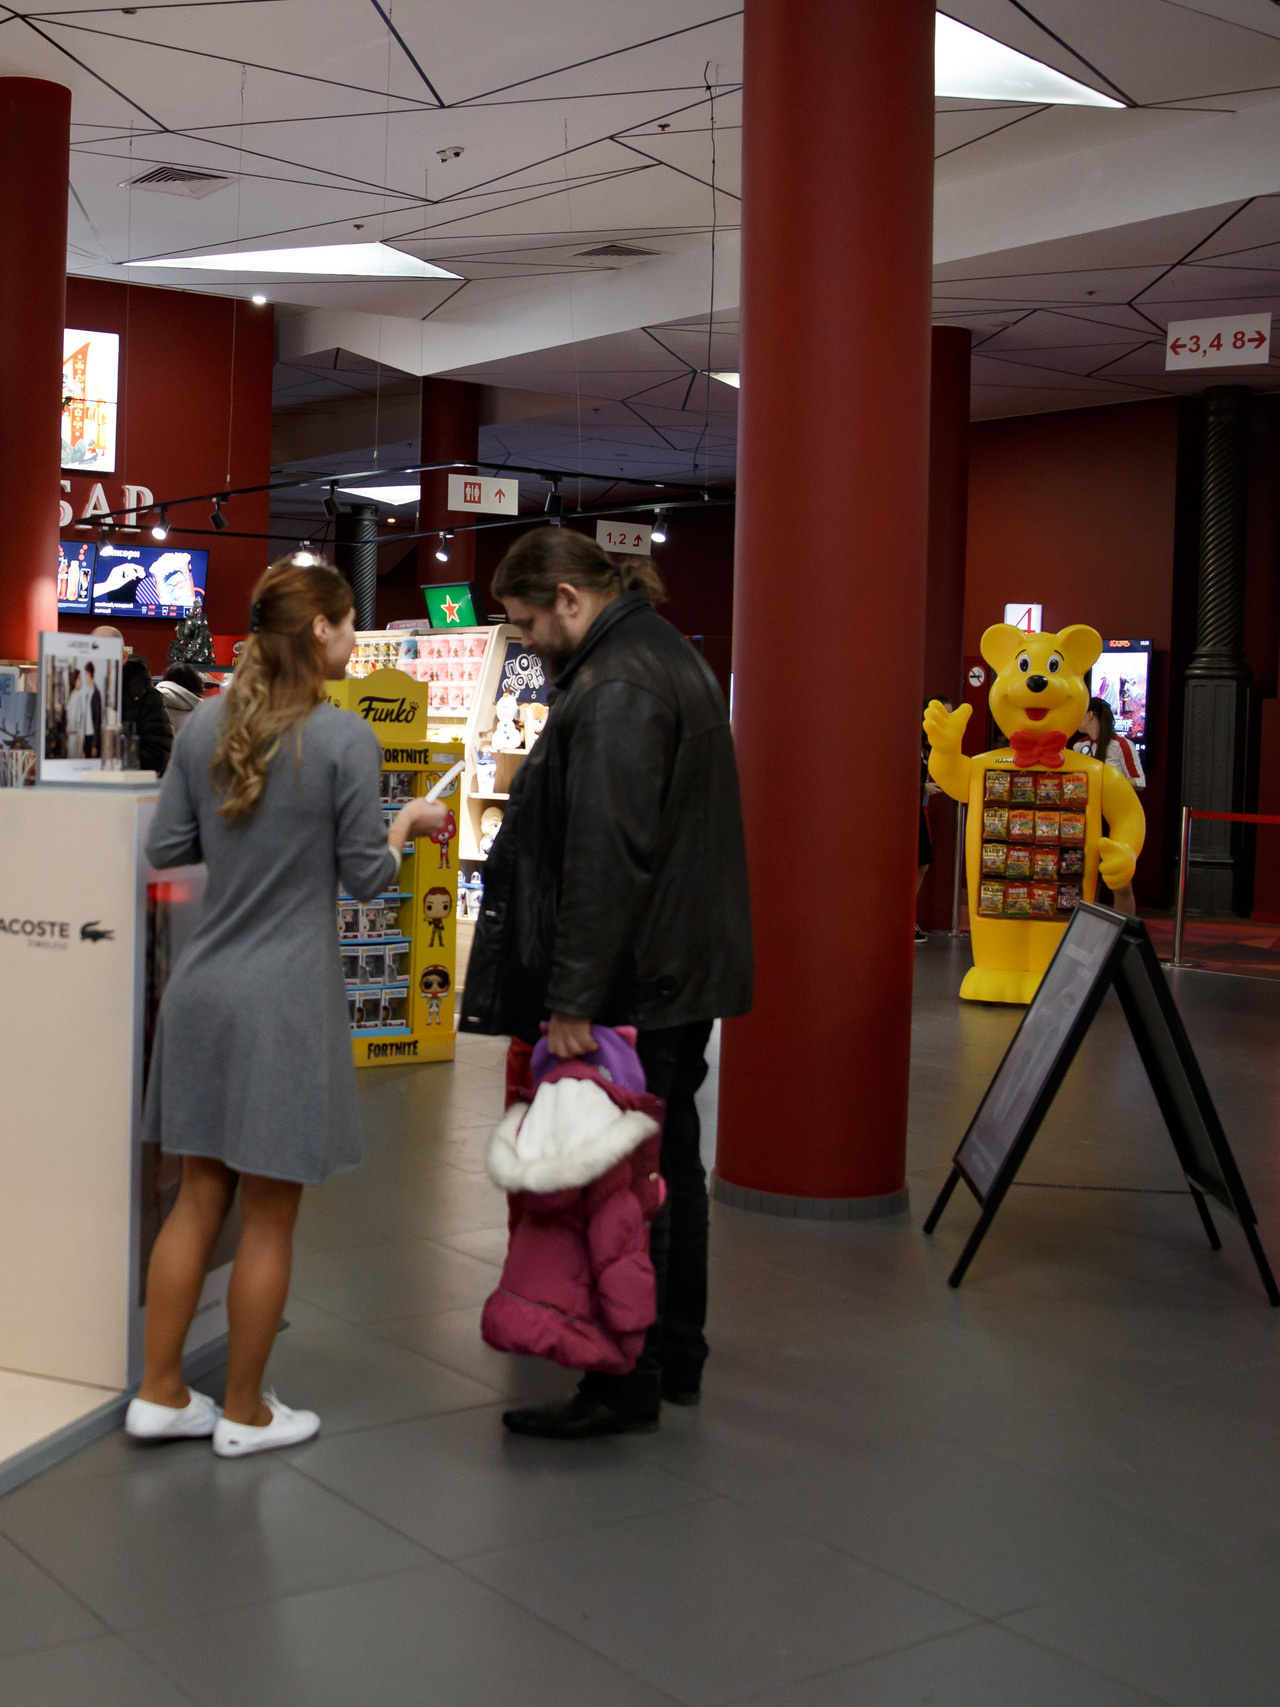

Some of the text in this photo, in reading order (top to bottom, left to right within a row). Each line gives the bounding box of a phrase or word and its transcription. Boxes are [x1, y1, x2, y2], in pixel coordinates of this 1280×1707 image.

[1187, 330, 1246, 358] 3,4 8
[606, 532, 627, 546] 1,2
[358, 696, 416, 724] Funko
[381, 748, 429, 765] ORTNITE
[367, 1040, 418, 1060] FORTNITE
